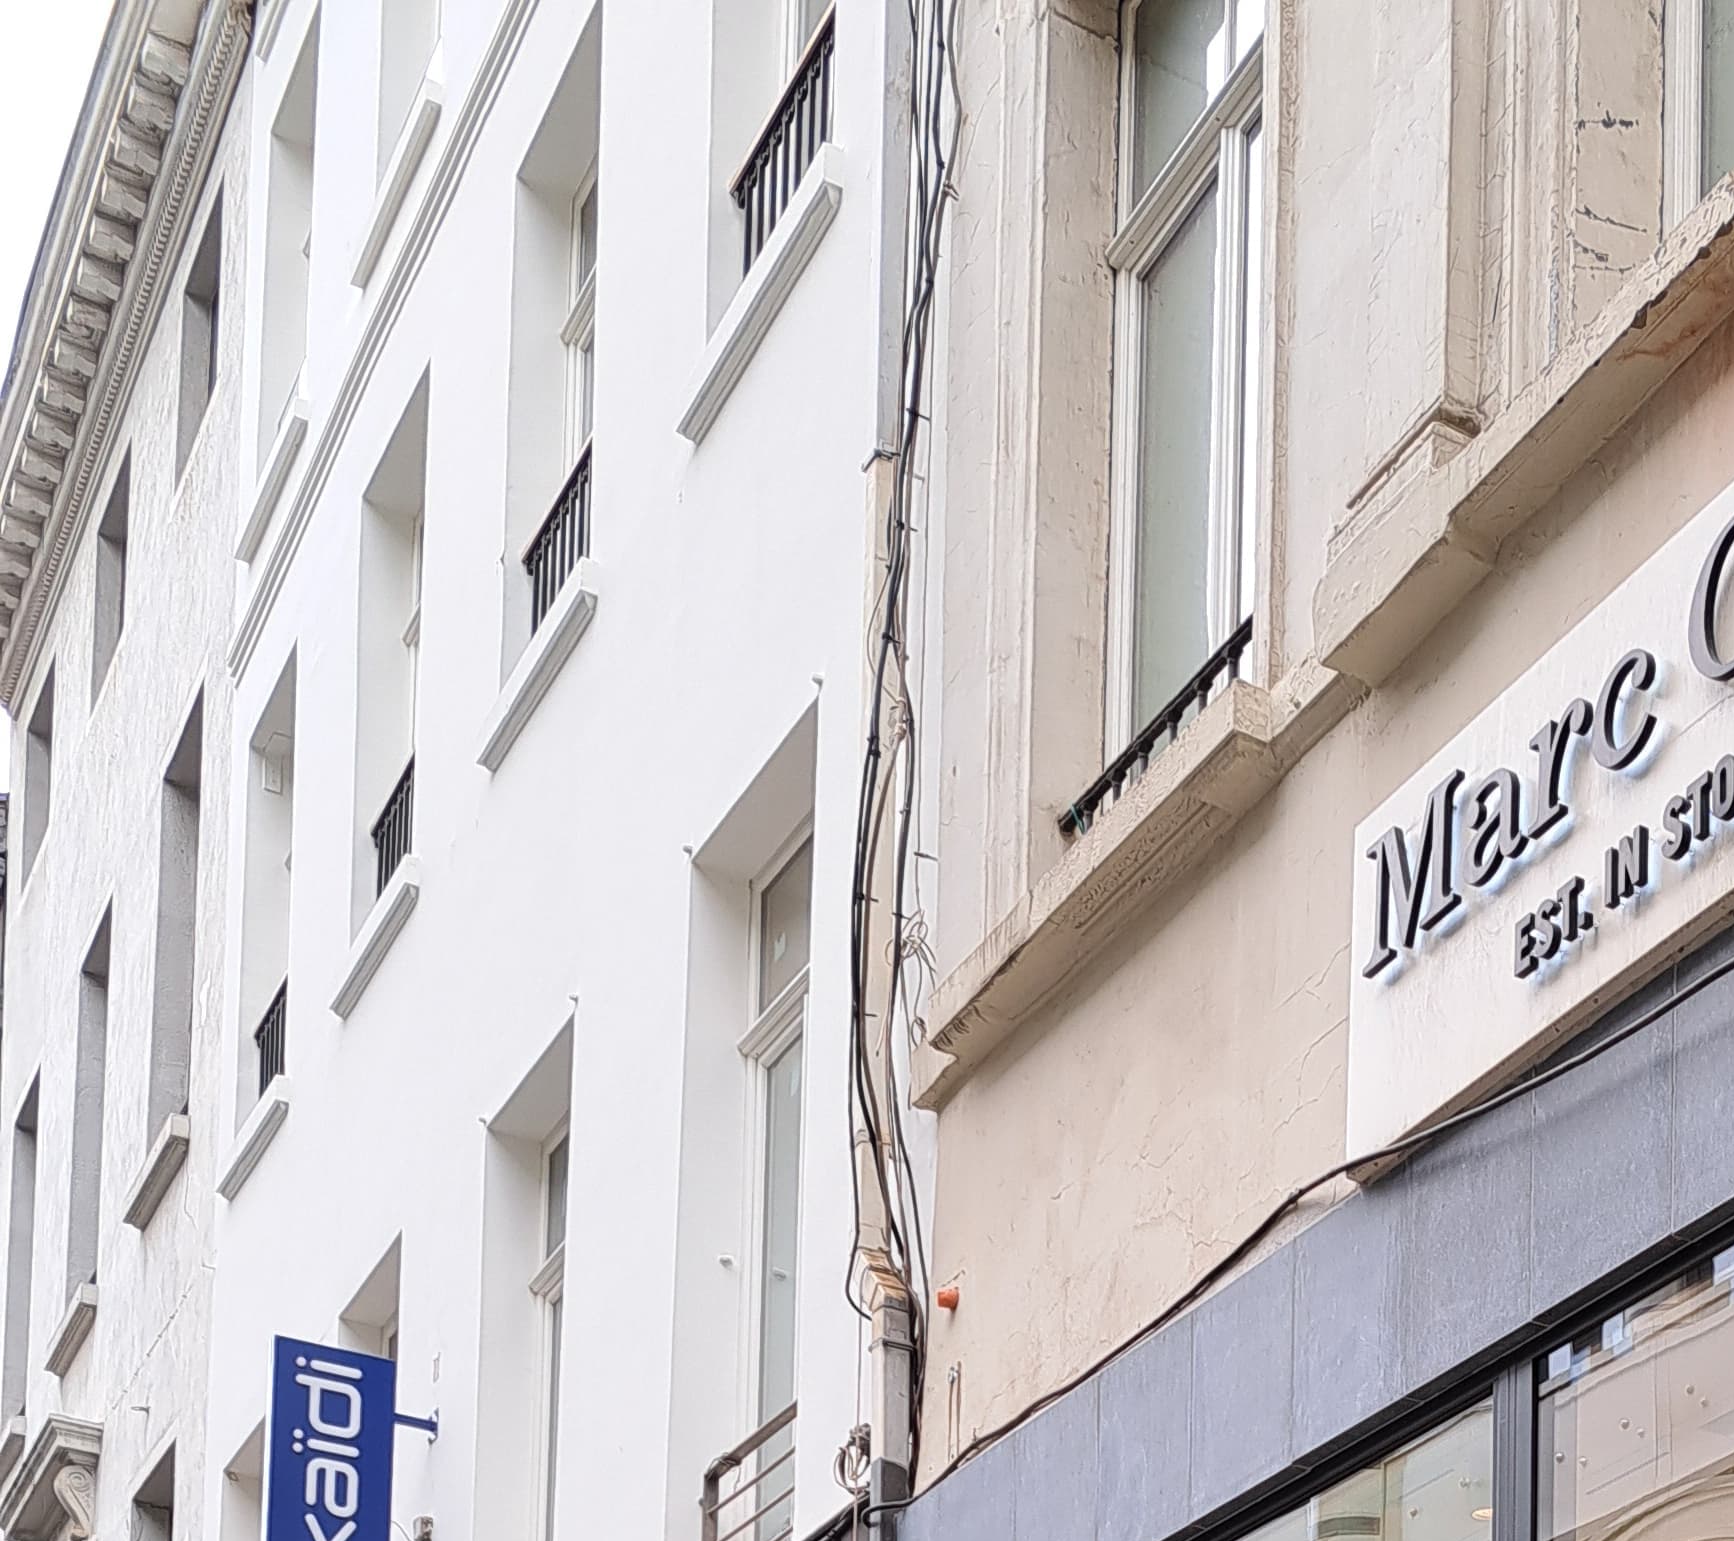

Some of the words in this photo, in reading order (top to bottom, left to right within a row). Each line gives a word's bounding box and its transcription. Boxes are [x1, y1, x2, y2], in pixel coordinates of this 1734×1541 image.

[1362, 647, 1657, 979] Marc
[1513, 875, 1595, 979] EST.
[1604, 825, 1649, 909] IN
